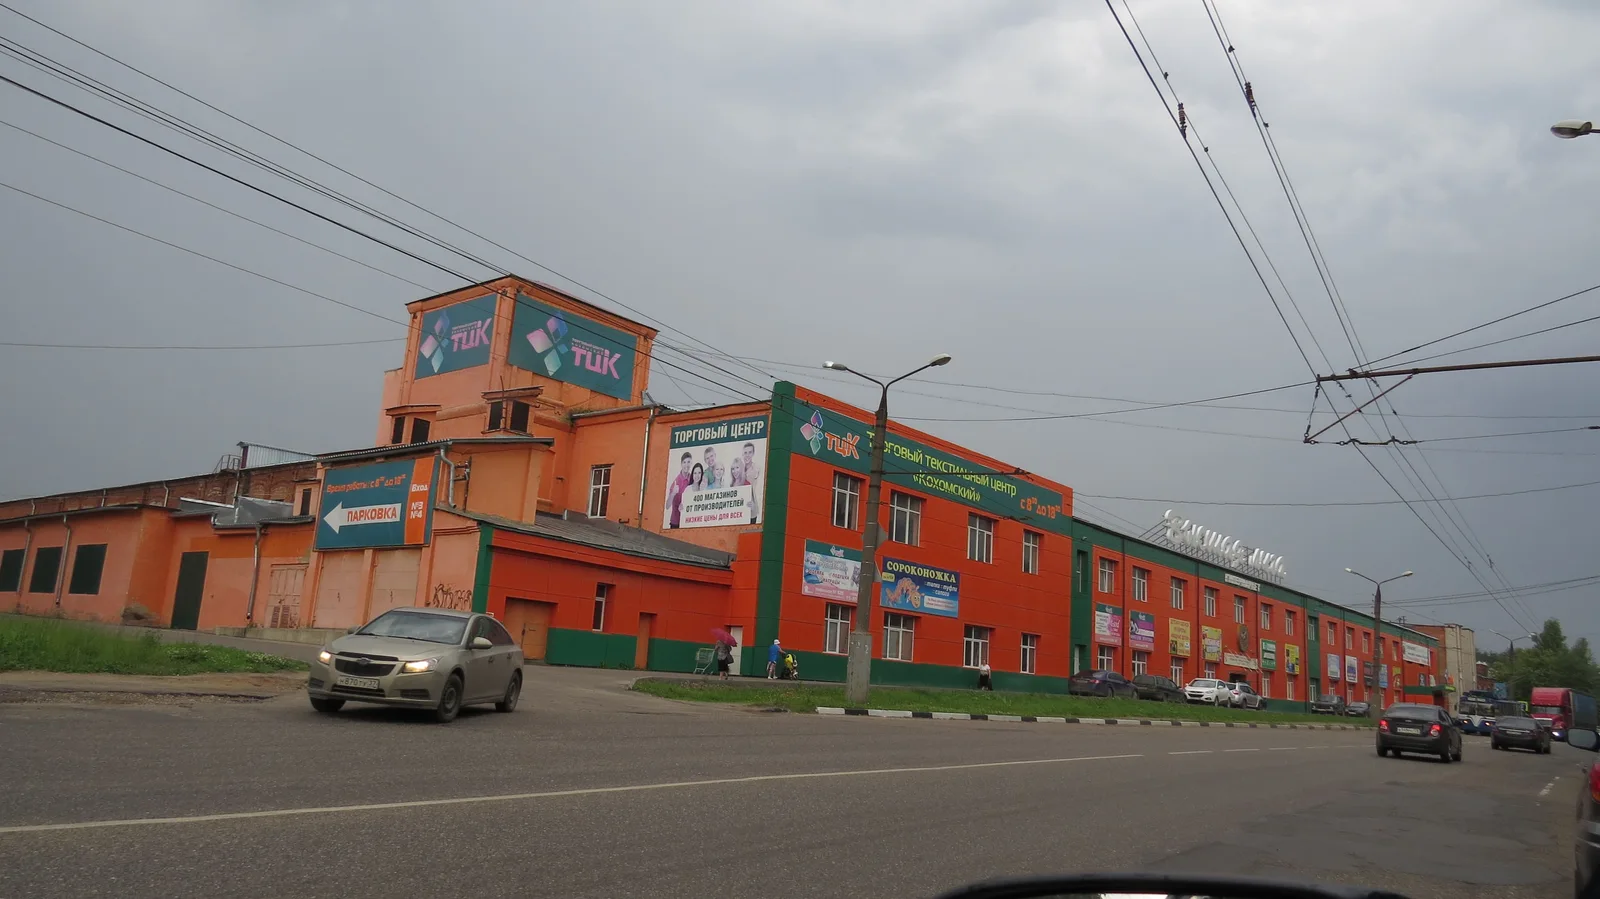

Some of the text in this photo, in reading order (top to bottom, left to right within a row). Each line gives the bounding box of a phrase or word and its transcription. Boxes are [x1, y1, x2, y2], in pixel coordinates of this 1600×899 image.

[674, 421, 764, 444] ТОРГОВЫЙ ЦЕНТР
[411, 483, 428, 492] Вход
[693, 490, 738, 502] 400 МАГАЗИНОВ
[411, 501, 424, 510] №3
[686, 498, 744, 513] ОТ ПРОИЗВОДИТЕЛЕЙ
[347, 507, 397, 522] ПАРКОВКА
[410, 510, 423, 519] №4
[703, 514, 718, 523] ЦЕНЫ
[730, 511, 743, 519] ВСЕХ
[886, 561, 956, 583] СОРОКОНОЖКА
